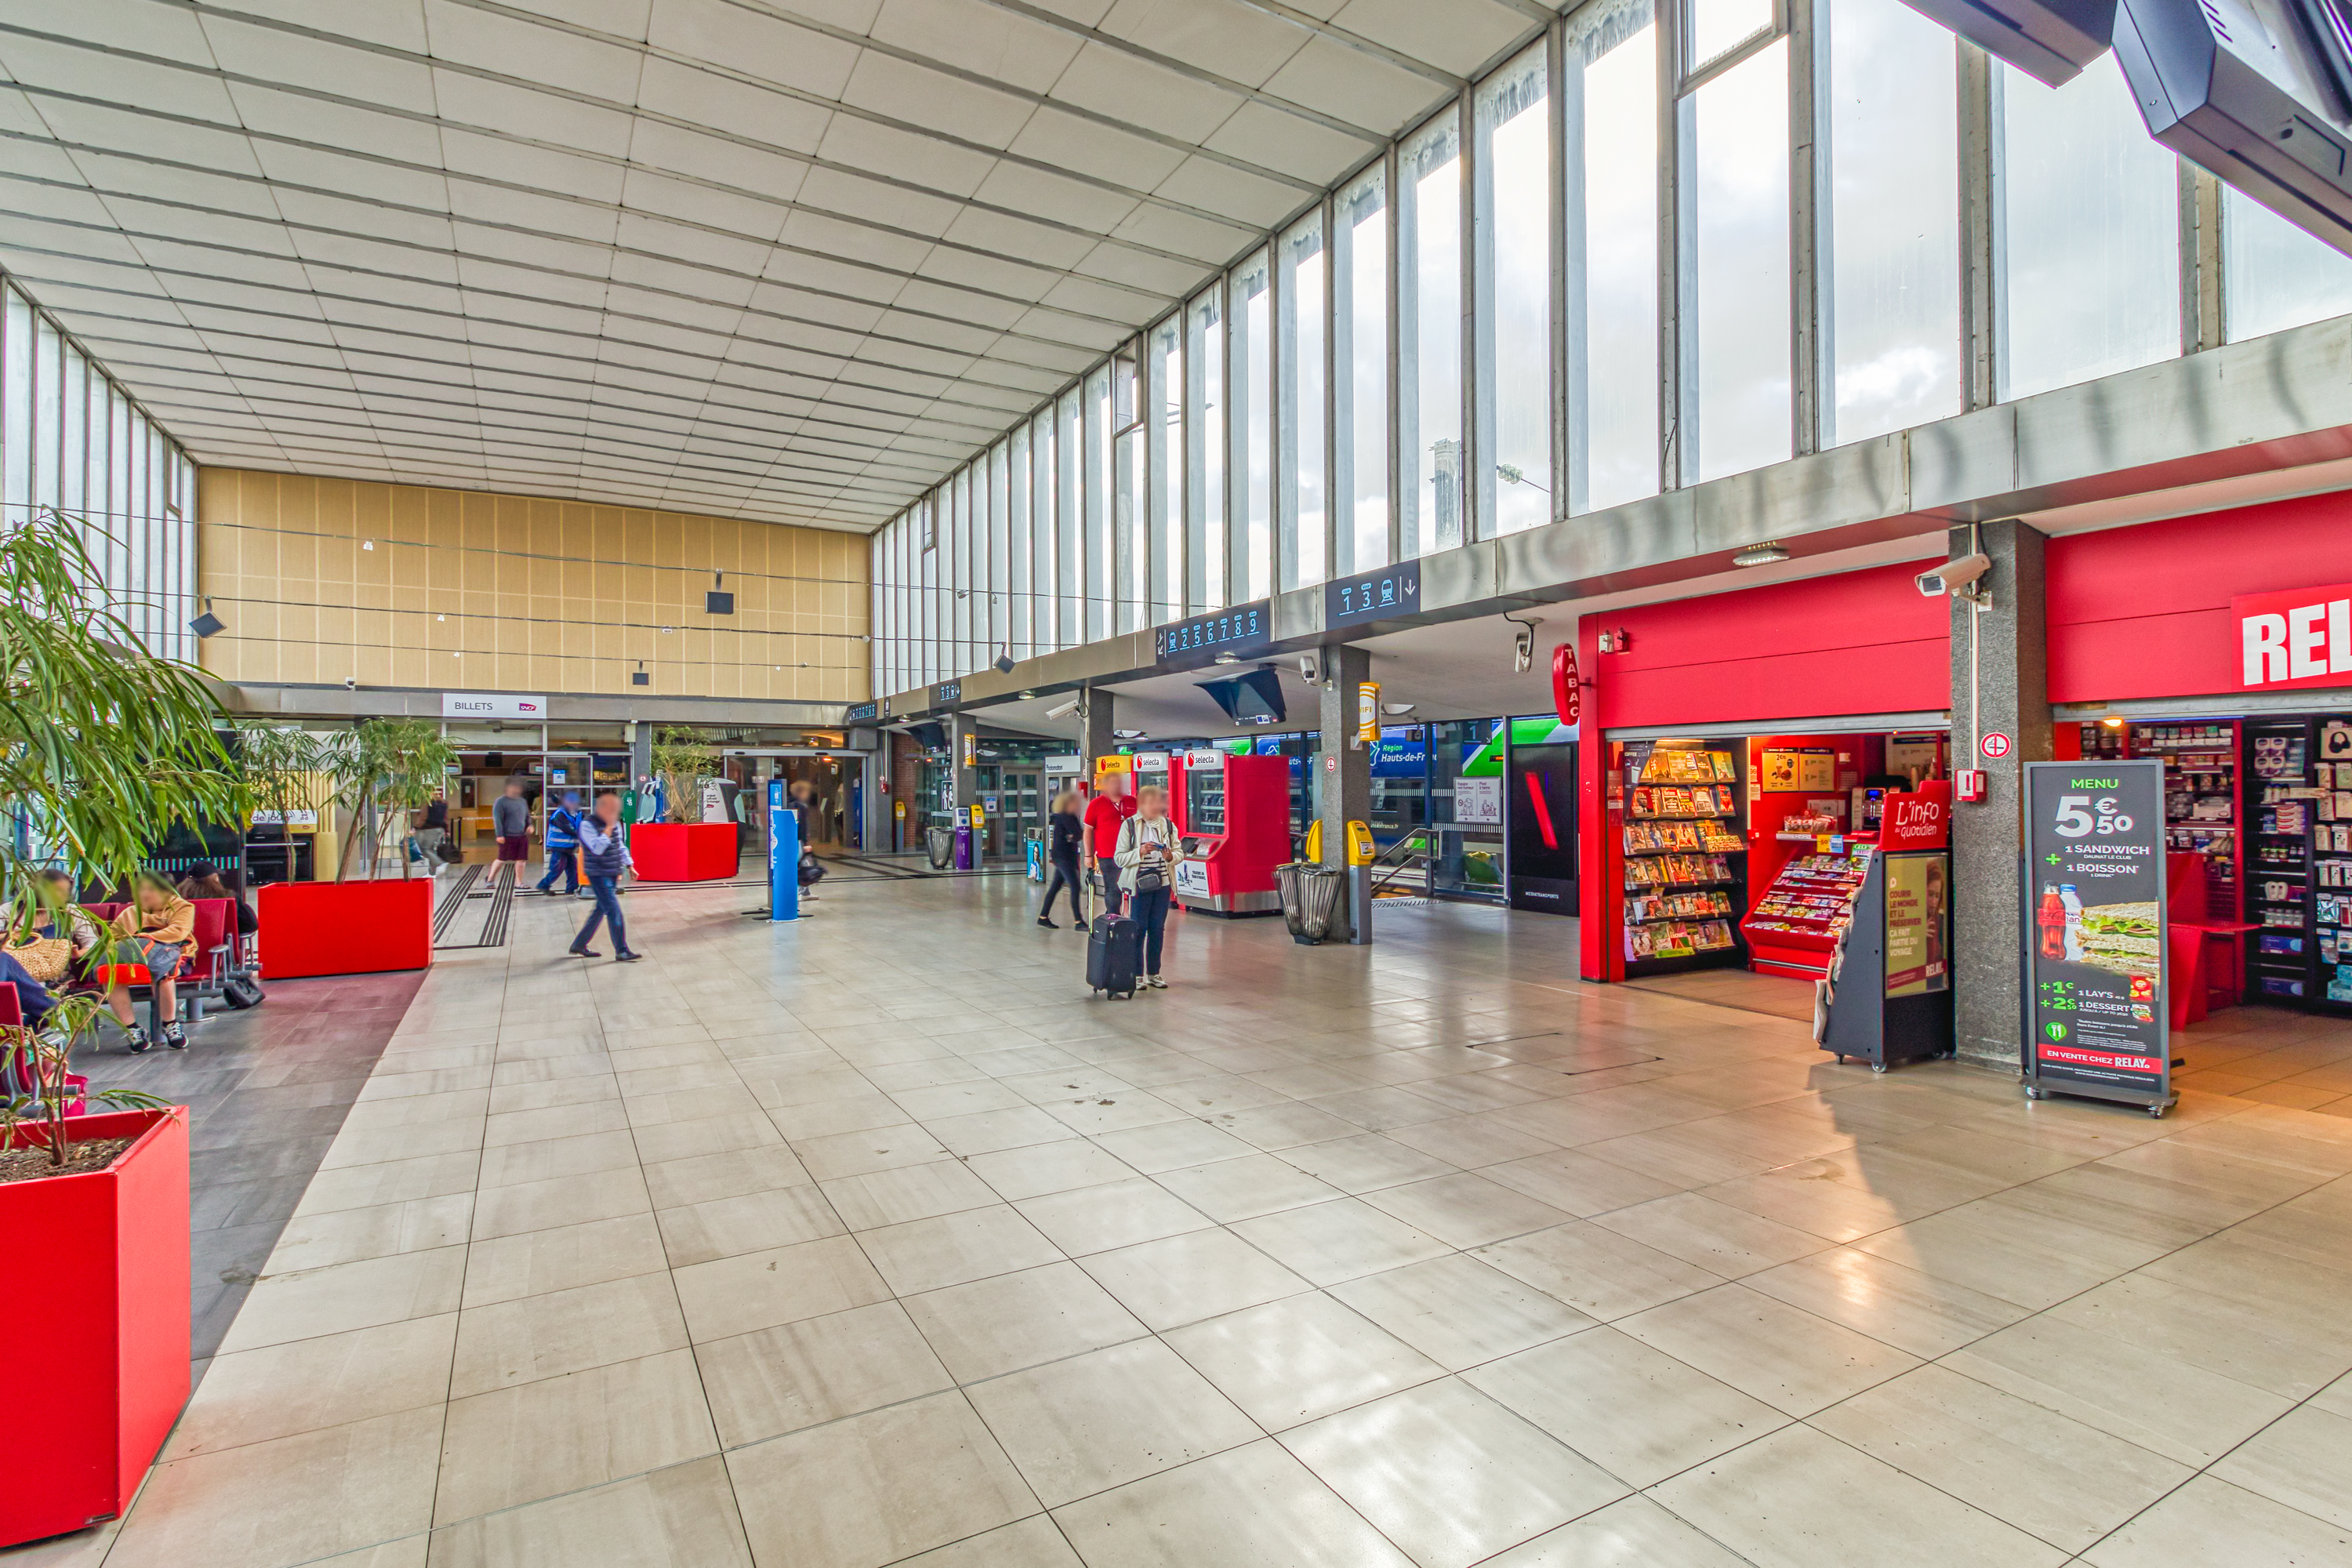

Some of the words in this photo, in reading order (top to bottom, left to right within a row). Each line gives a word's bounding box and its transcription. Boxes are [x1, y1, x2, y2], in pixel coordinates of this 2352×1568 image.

[1344, 596, 1349, 611] 1
[1363, 591, 1370, 607] 3
[1182, 634, 1187, 647] 2
[1195, 631, 1200, 644] 5
[1207, 628, 1214, 641] 6
[1221, 625, 1226, 638] 7
[1236, 622, 1241, 635] 8
[1250, 619, 1256, 632] 9
[1565, 649, 1579, 717] TABAC
[2071, 779, 2118, 789] MENU
[1896, 800, 1940, 825] L'info
[1900, 823, 1937, 840] quotidien
[2074, 845, 2150, 855] SANDWICH
[1526, 891, 1559, 899] MEDIATRANSPORTS
[1889, 890, 1911, 898] COURIR
[1897, 899, 1918, 908] MONDE
[1889, 917, 1921, 927] PRÉSERVER
[1889, 938, 1908, 947] PARTIE
[1889, 947, 1912, 956] VOYAGE
[2085, 990, 2114, 999] LAY'S
[2085, 1002, 2129, 1011] DESSERT
[2060, 1052, 2089, 1061] VENTE
[2089, 1055, 2112, 1065] CHEZ
